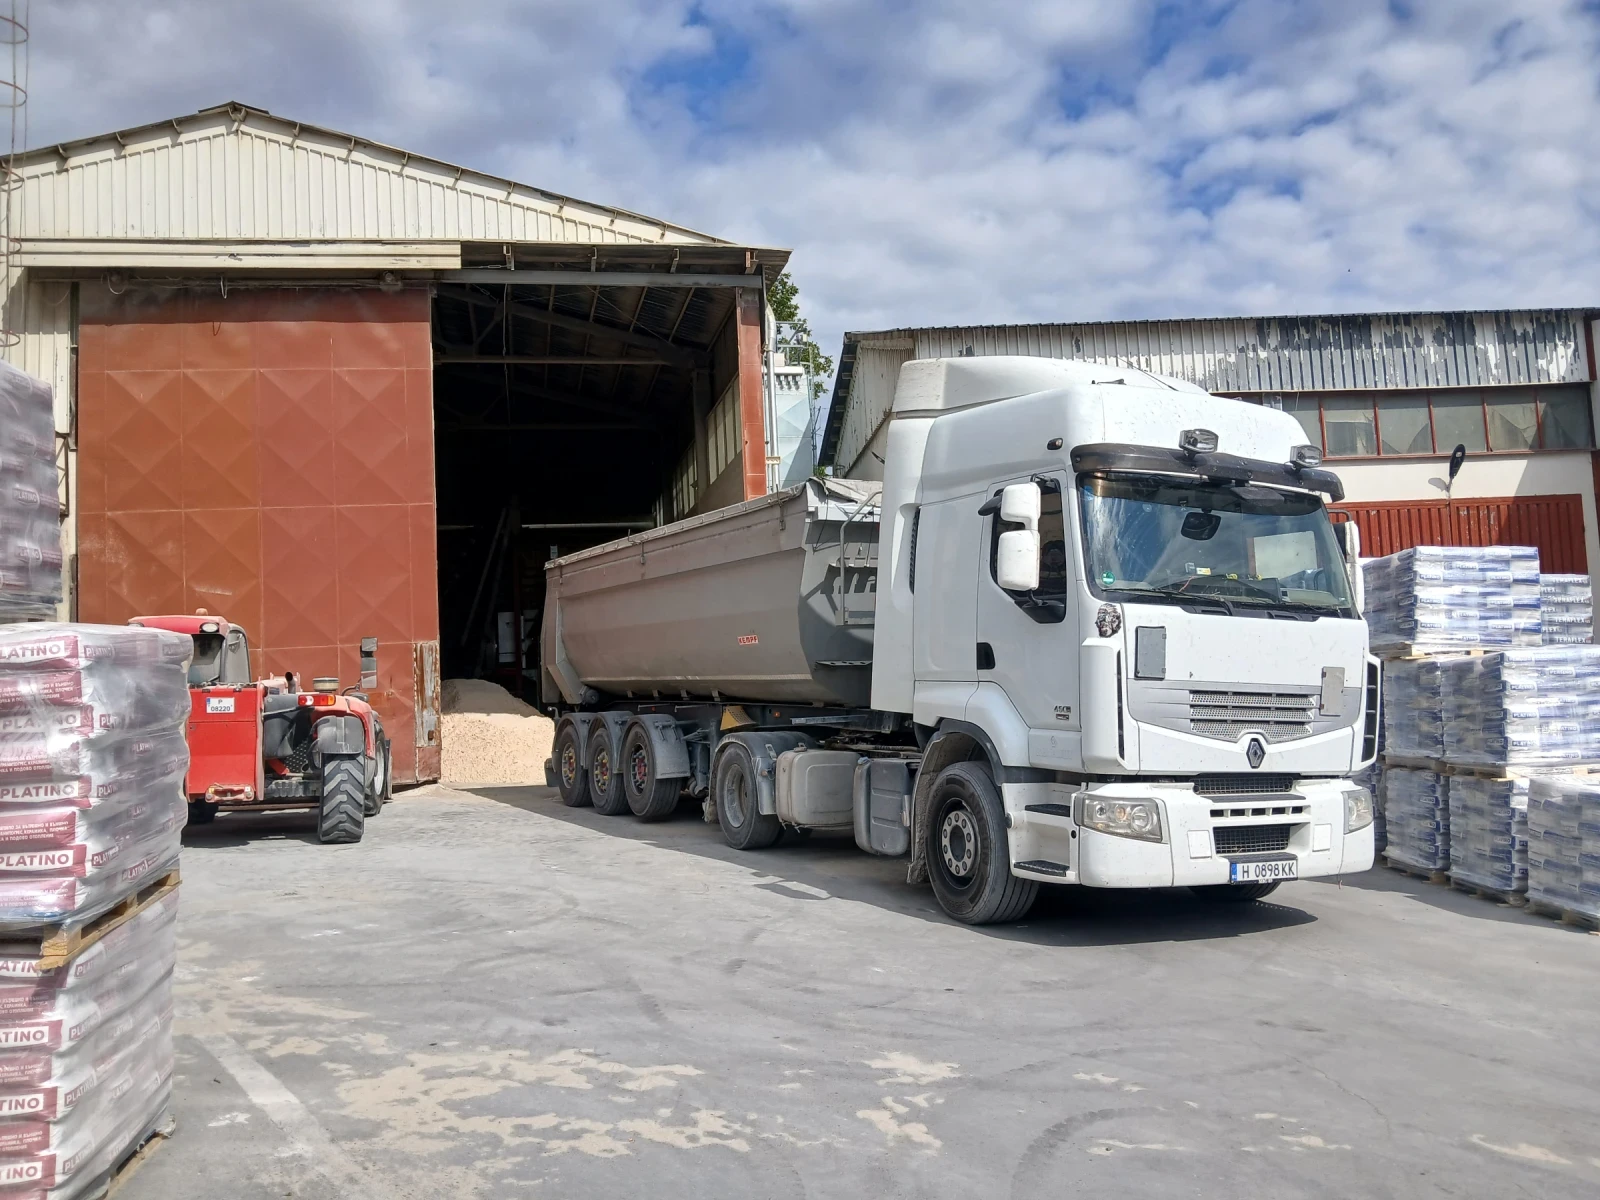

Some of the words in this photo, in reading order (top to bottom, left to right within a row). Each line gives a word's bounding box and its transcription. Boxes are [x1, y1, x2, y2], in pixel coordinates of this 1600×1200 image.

[0, 643, 61, 660] LATINO
[0, 784, 75, 799] PLATINO
[1242, 865, 1249, 879] H
[1254, 863, 1280, 878] 0898
[1281, 862, 1295, 876] KK
